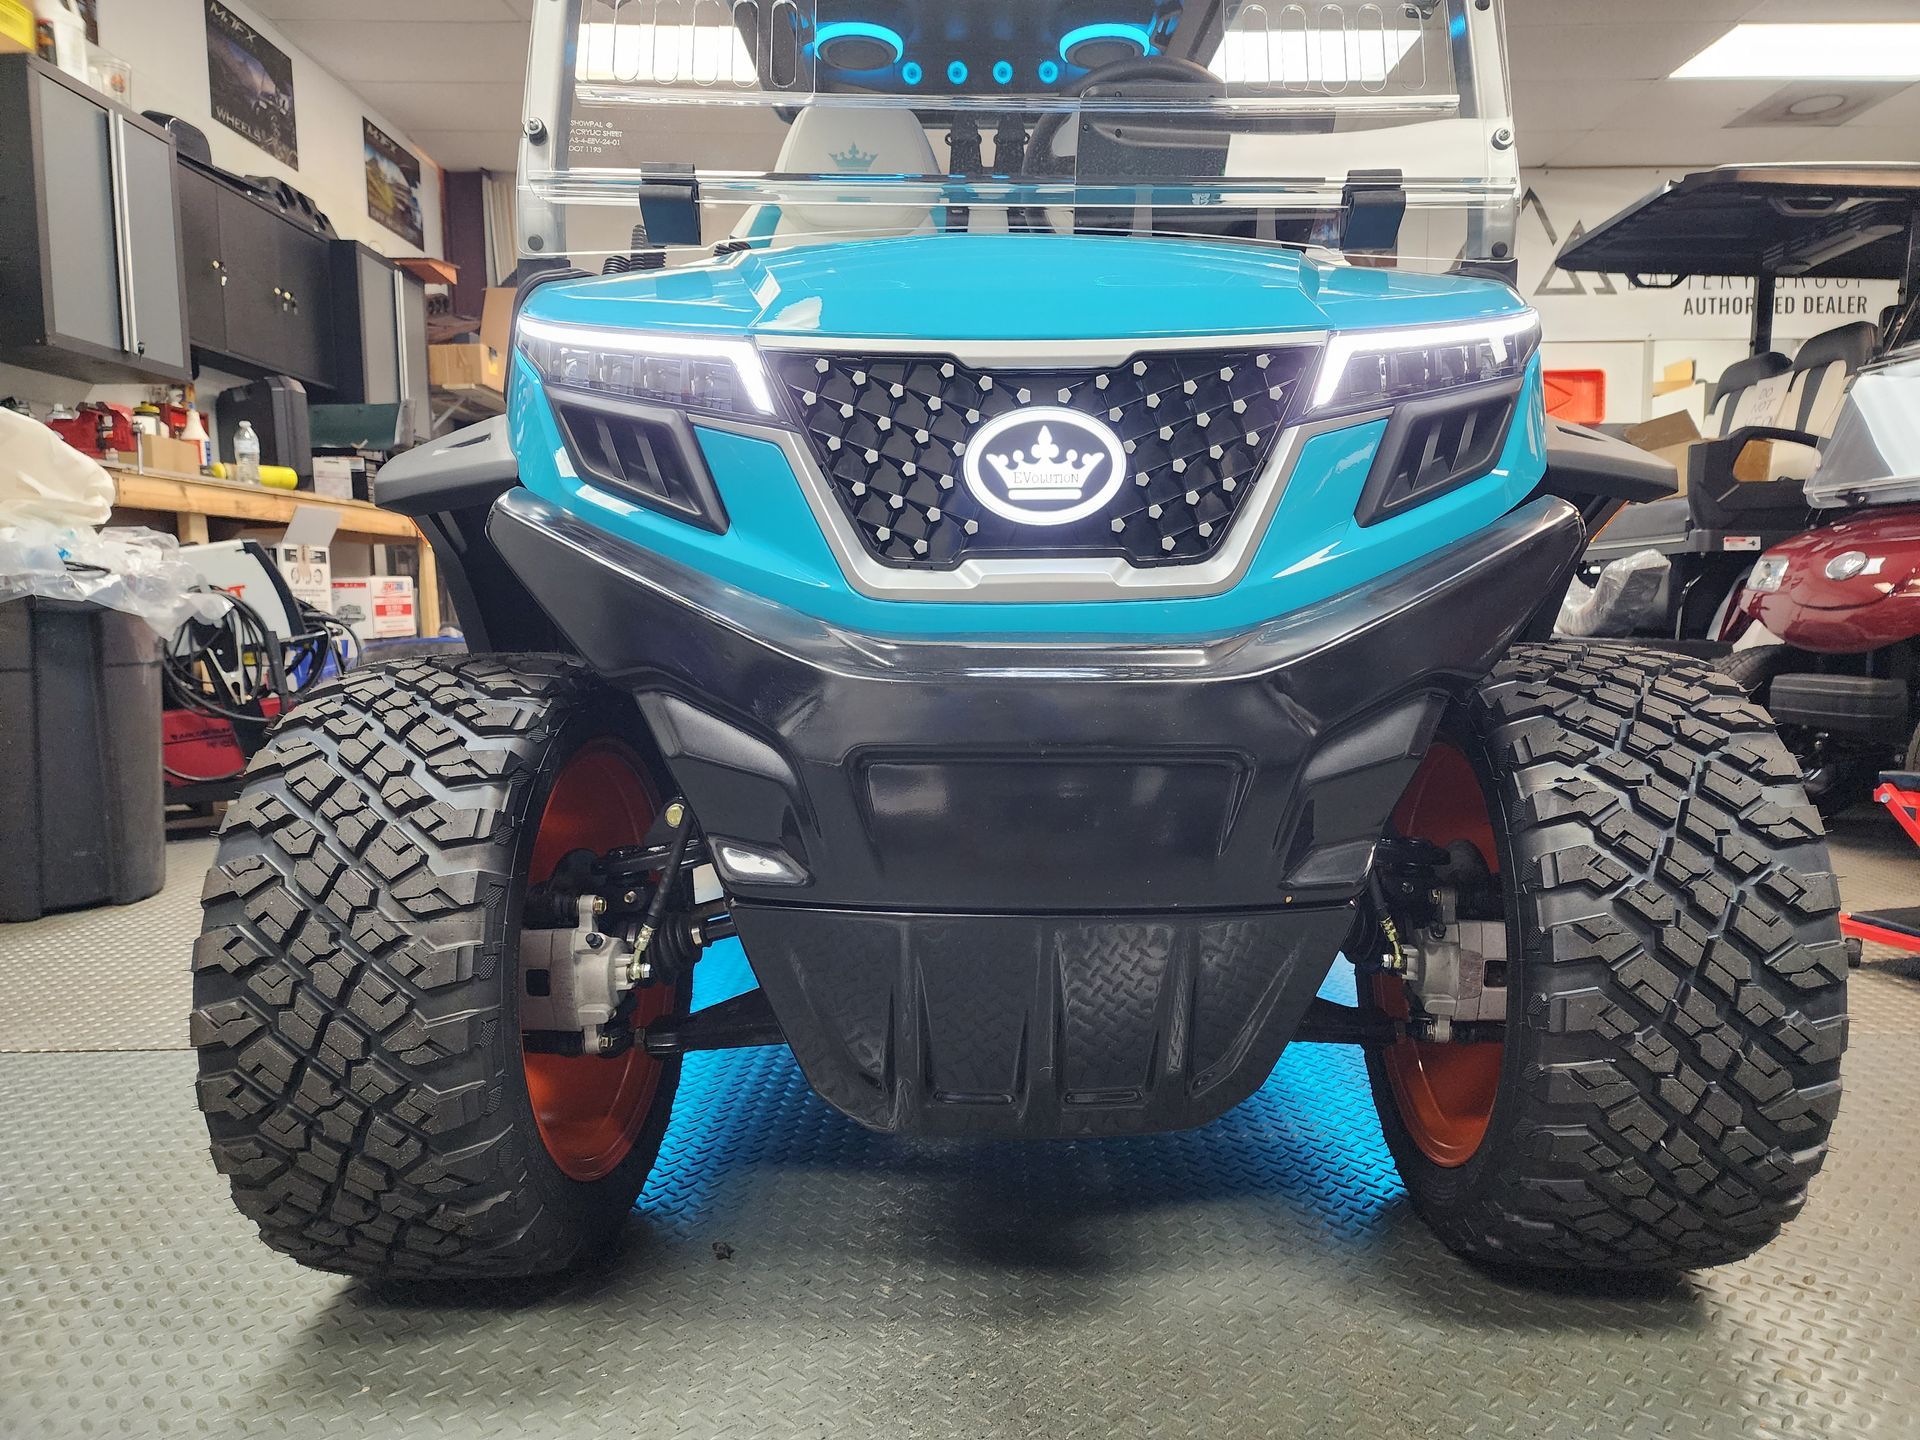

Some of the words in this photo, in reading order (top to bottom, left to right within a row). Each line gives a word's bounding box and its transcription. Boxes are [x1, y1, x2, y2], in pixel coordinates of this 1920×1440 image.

[215, 105, 262, 142] WHEELS
[570, 120, 603, 128] SHOWPAL
[570, 128, 601, 136] ACRYLIC
[1804, 296, 1867, 314] DEALER
